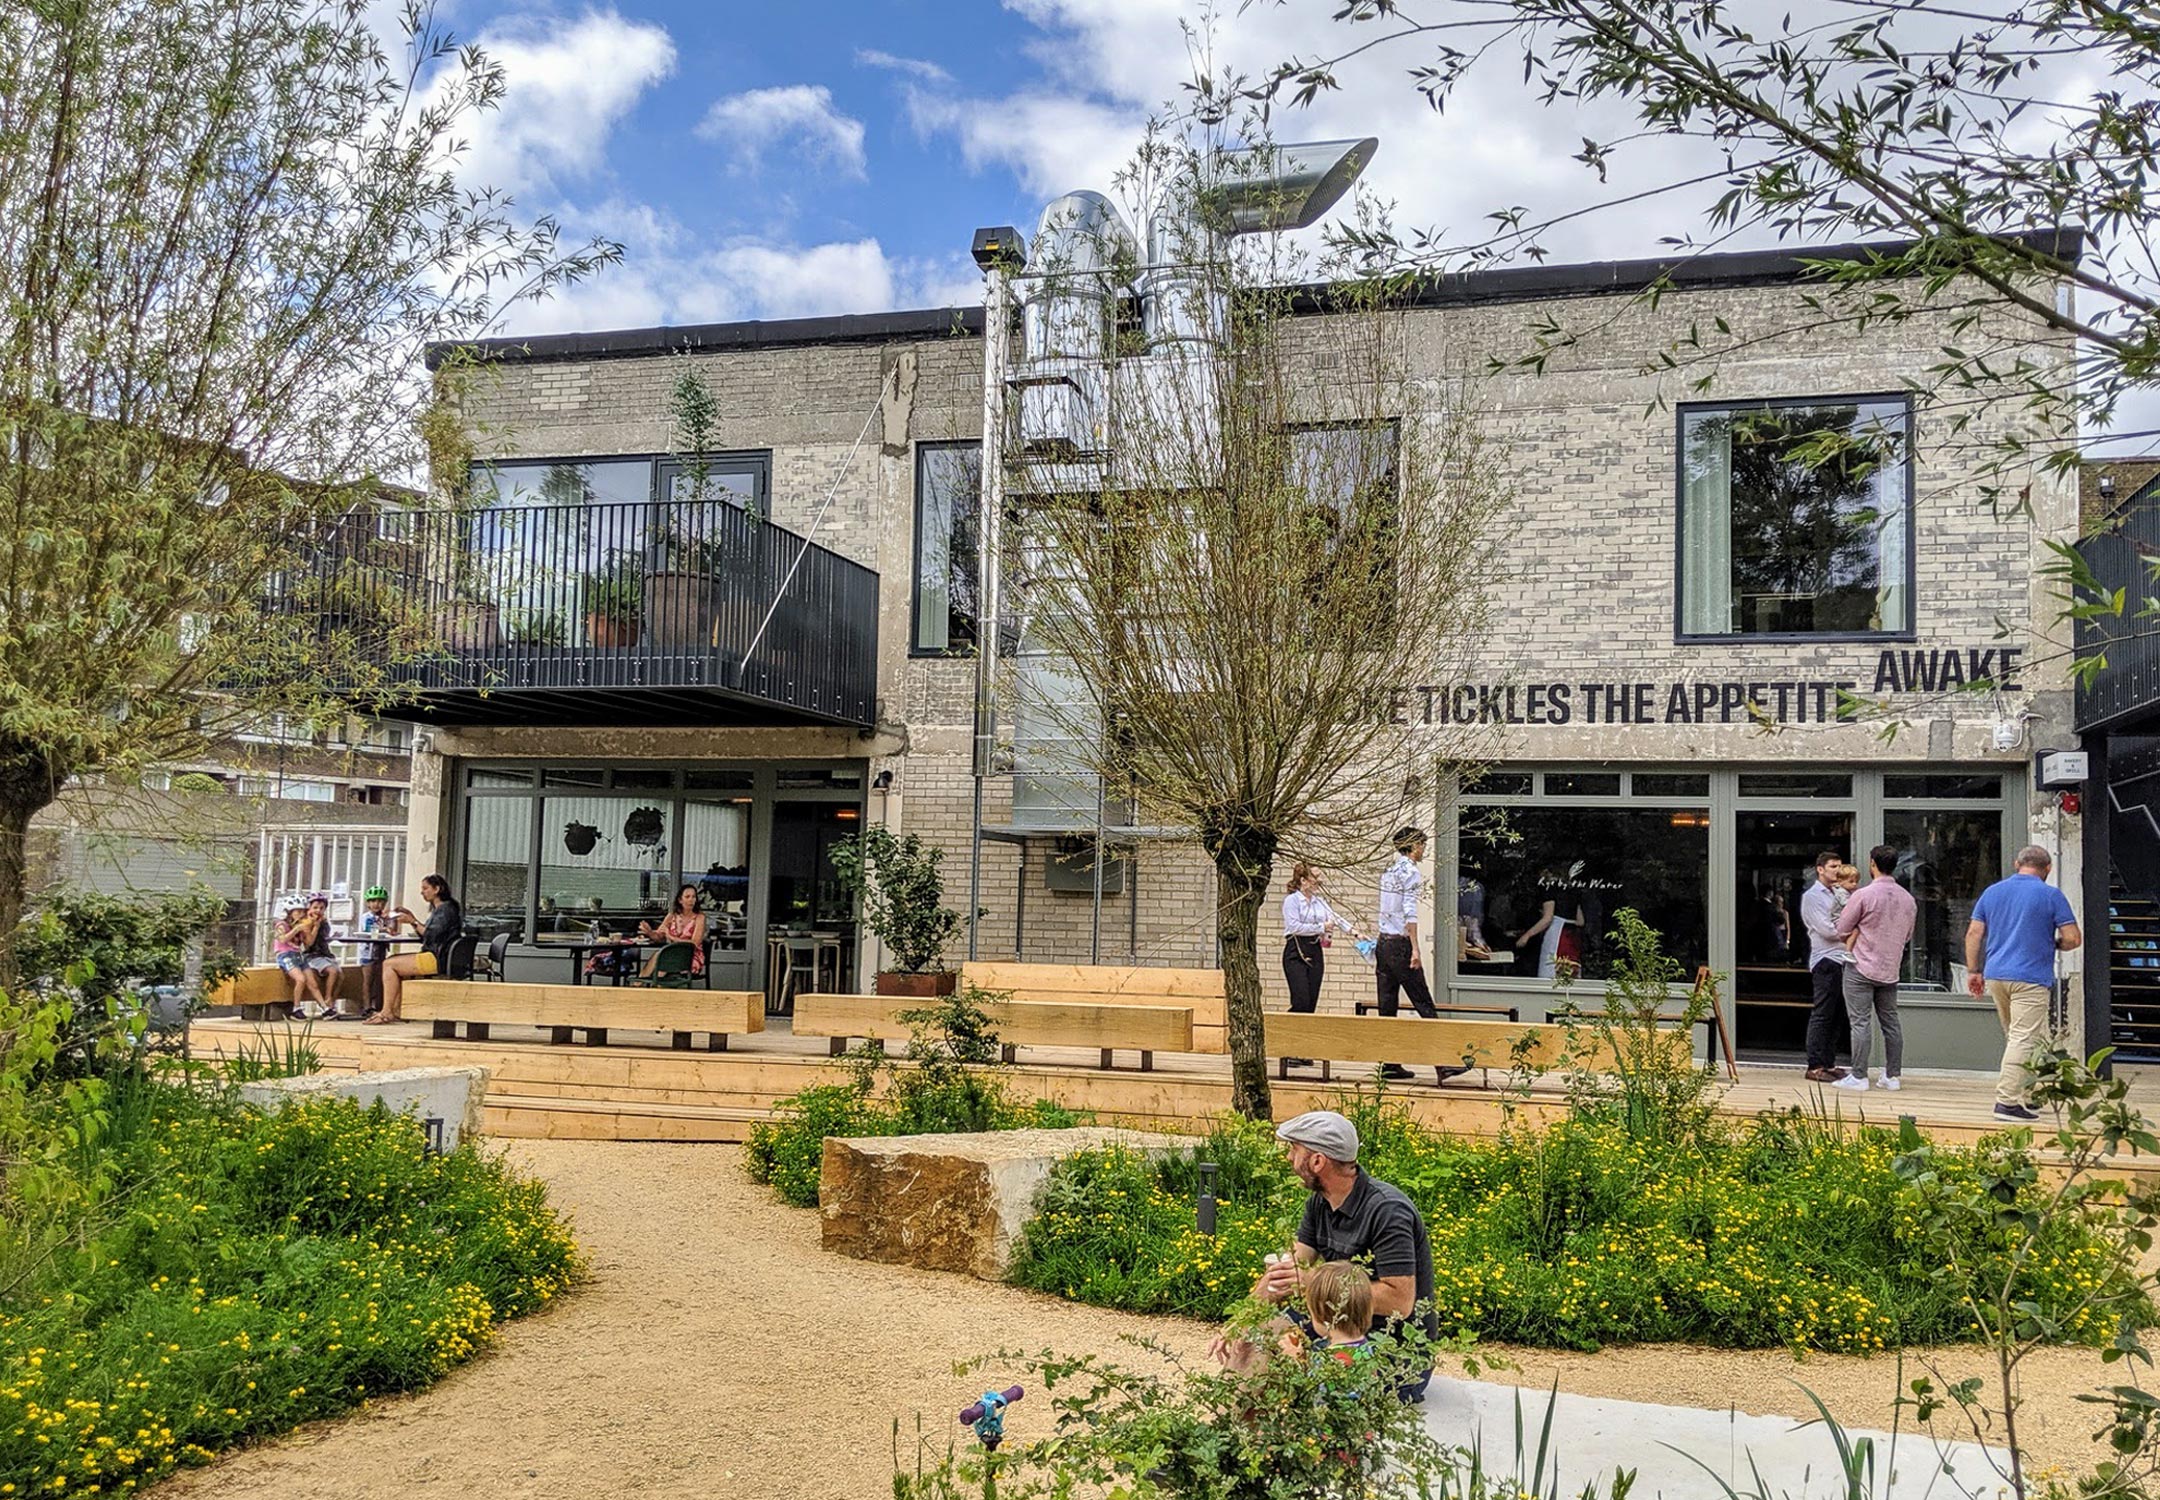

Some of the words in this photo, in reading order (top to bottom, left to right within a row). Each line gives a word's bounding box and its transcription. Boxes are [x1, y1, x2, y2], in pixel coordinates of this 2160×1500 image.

[1416, 684, 1571, 725] TICKLES
[1580, 684, 1655, 724] THE
[1665, 682, 1857, 724] APPETITE
[1874, 648, 2023, 692] AWAKE
[1589, 878, 1623, 889] Water
